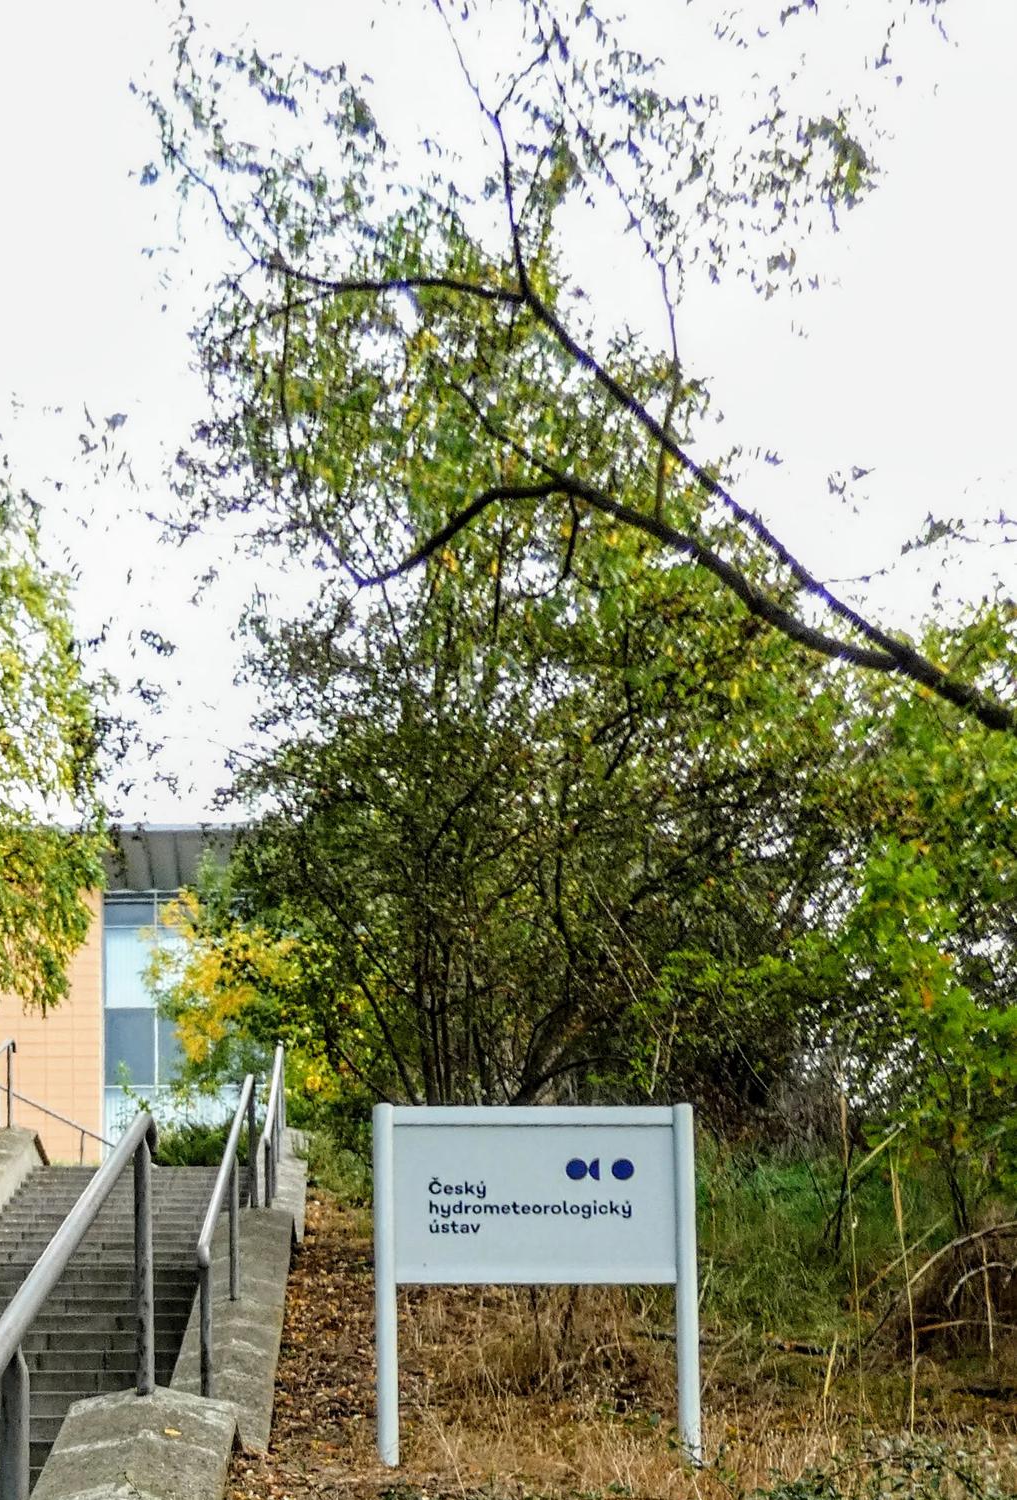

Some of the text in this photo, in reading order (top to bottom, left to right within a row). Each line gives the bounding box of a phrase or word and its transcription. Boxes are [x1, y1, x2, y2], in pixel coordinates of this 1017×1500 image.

[428, 1177, 487, 1199] Český
[428, 1199, 632, 1220] hydrometeorologický
[428, 1219, 481, 1235] ústav
